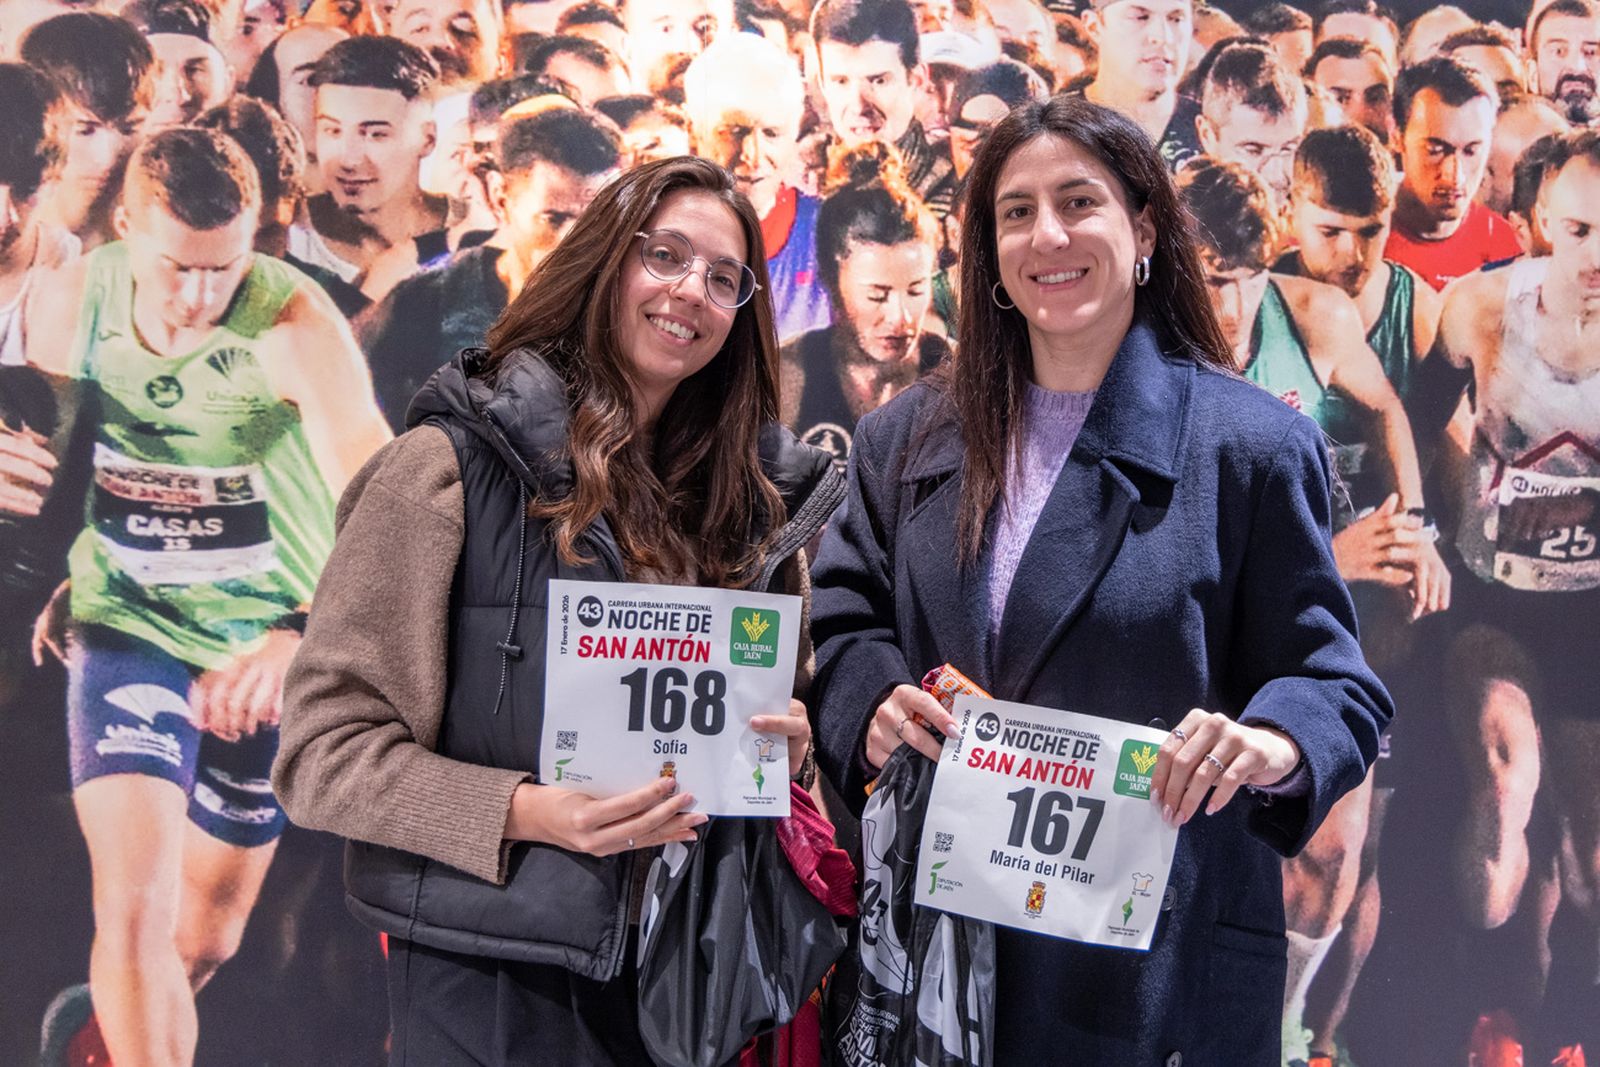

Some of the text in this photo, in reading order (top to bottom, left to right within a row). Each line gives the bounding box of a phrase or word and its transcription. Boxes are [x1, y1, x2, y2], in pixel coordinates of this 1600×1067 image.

[127, 514, 223, 537] CASAS
[1541, 525, 1597, 558] 25
[578, 603, 601, 619] 43
[608, 600, 712, 612] CARRERA URBANA INTERNACIONAL
[561, 594, 570, 655] 17 Enero de 2026
[607, 610, 713, 634] NOCHE DE
[577, 633, 711, 663] SAN ANTÓN
[733, 642, 774, 653] CAJA RURAL
[620, 667, 727, 736] 168
[952, 754, 960, 762] 17
[962, 709, 972, 726] 2026
[976, 718, 998, 735] 43
[1005, 718, 1101, 741] CARRERA URBANA INTERNACIONAL
[1000, 727, 1100, 762] NOCHE DE
[967, 747, 1095, 790] SAN ANTÓN
[1007, 786, 1106, 861] 167
[990, 850, 1095, 885] María del Pilar
